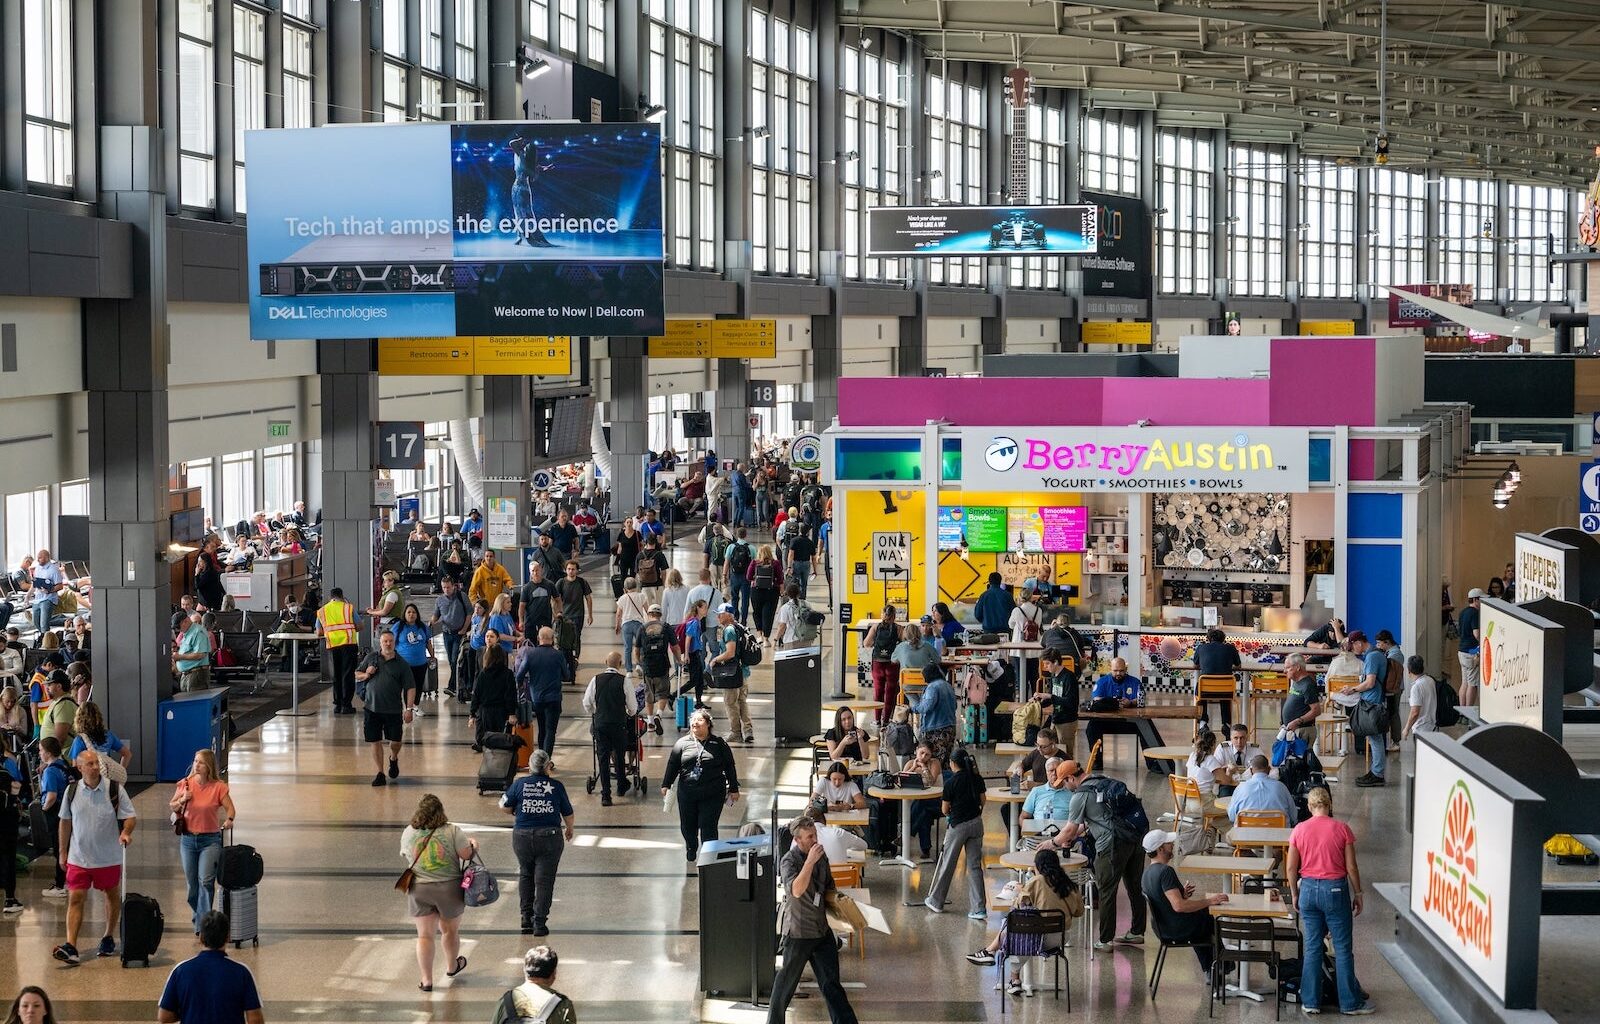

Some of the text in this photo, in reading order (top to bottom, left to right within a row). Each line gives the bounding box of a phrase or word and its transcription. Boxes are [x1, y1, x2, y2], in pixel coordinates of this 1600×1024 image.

[286, 214, 620, 239] Tech that amps the experience
[411, 273, 444, 286] DELL
[494, 306, 545, 317] Welcome
[546, 307, 559, 317] to
[561, 306, 587, 317] Now
[595, 306, 644, 317] Dell.com
[489, 336, 522, 344] Baggage
[753, 386, 773, 401] 18
[272, 425, 289, 436] EXIT
[385, 433, 418, 458] 17
[1041, 478, 1244, 489] YOGURT SMOOTHIES BOWLS
[1003, 554, 1050, 565] AUSTIN
[1523, 551, 1558, 590] HIPPIES
[1514, 692, 1539, 711] TORTILLA
[522, 799, 552, 807] PEOPLE
